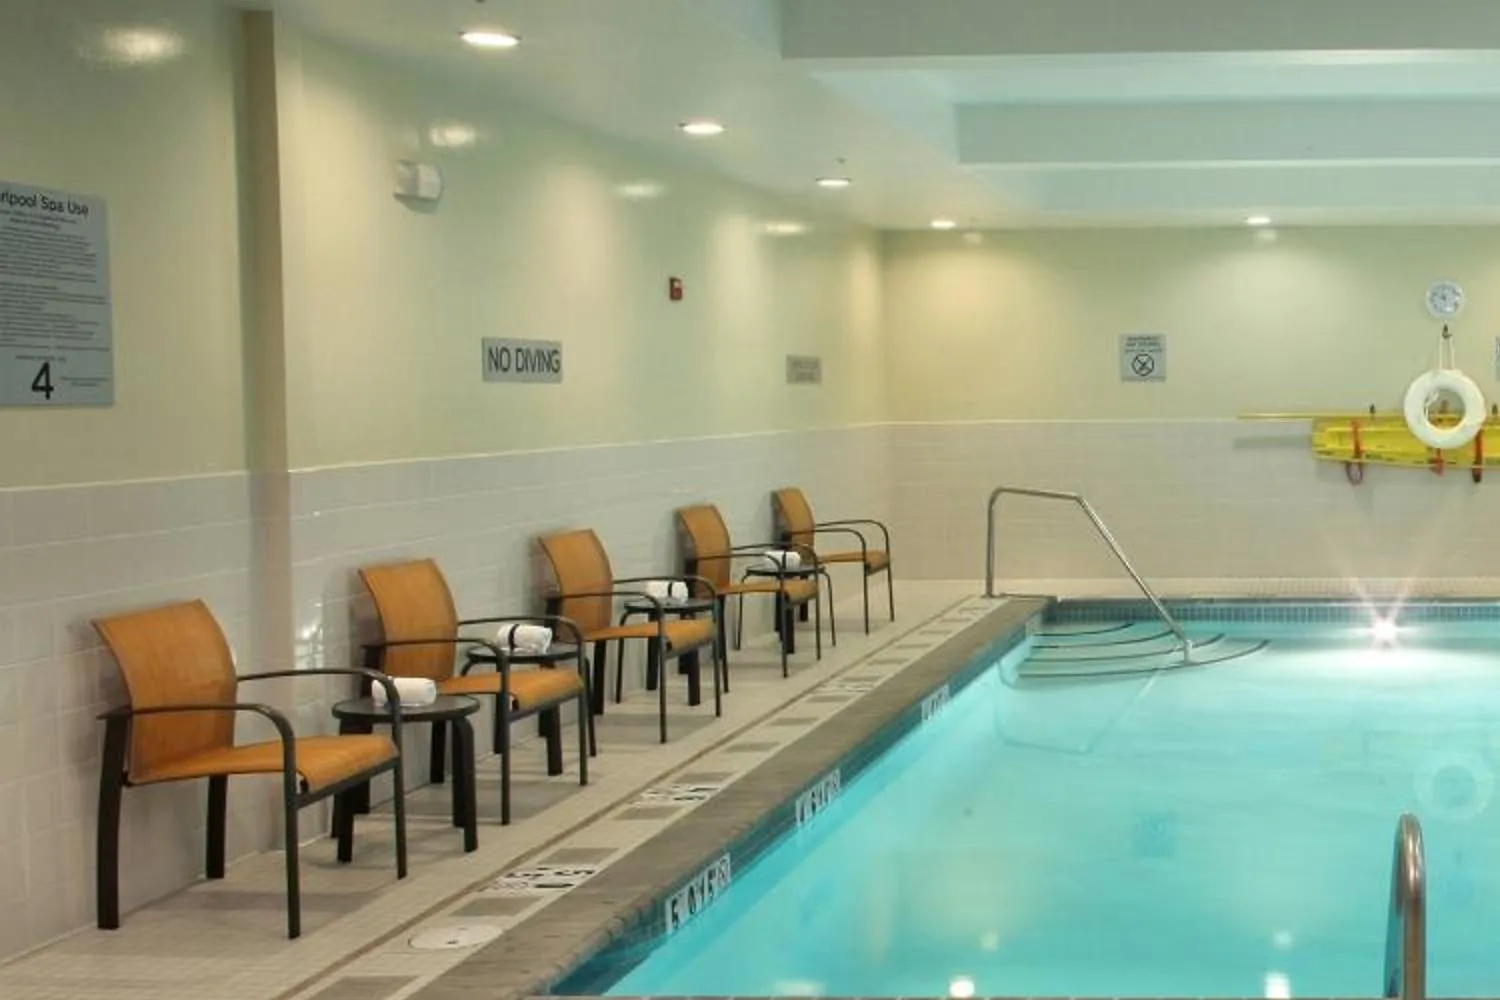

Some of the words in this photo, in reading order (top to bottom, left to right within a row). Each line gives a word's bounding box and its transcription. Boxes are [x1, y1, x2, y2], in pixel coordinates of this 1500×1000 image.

[40, 194, 65, 213] Spa
[67, 199, 89, 216] Use
[488, 346, 510, 373] NO
[515, 347, 561, 374] DIVING
[31, 361, 54, 400] 4
